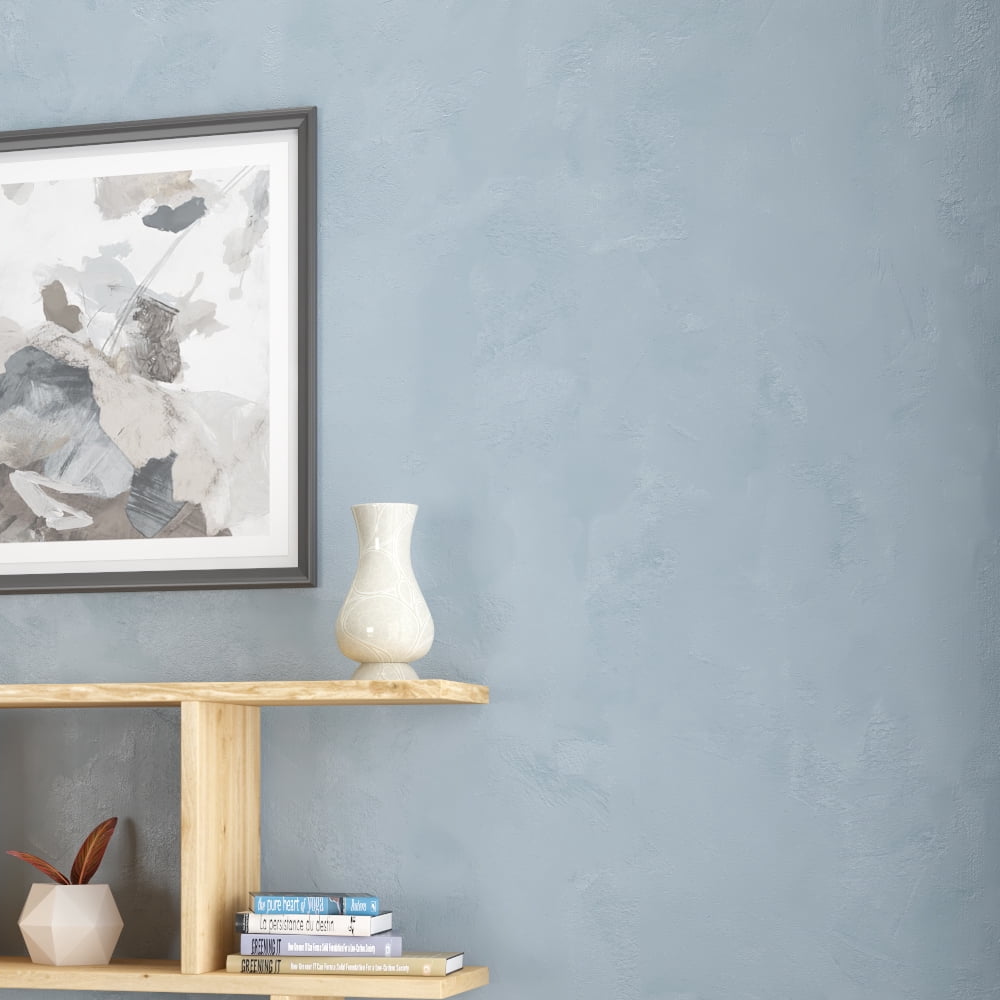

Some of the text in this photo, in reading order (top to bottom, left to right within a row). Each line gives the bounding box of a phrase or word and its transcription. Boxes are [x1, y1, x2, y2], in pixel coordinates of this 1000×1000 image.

[266, 899, 281, 914] pure
[282, 896, 299, 912] heart
[307, 896, 324, 914] yoga
[260, 915, 267, 930] La
[269, 915, 304, 933] persistance
[306, 915, 314, 931] du
[315, 915, 335, 932] destin
[251, 938, 275, 955] GREENING
[241, 958, 282, 975] GREENING IT
